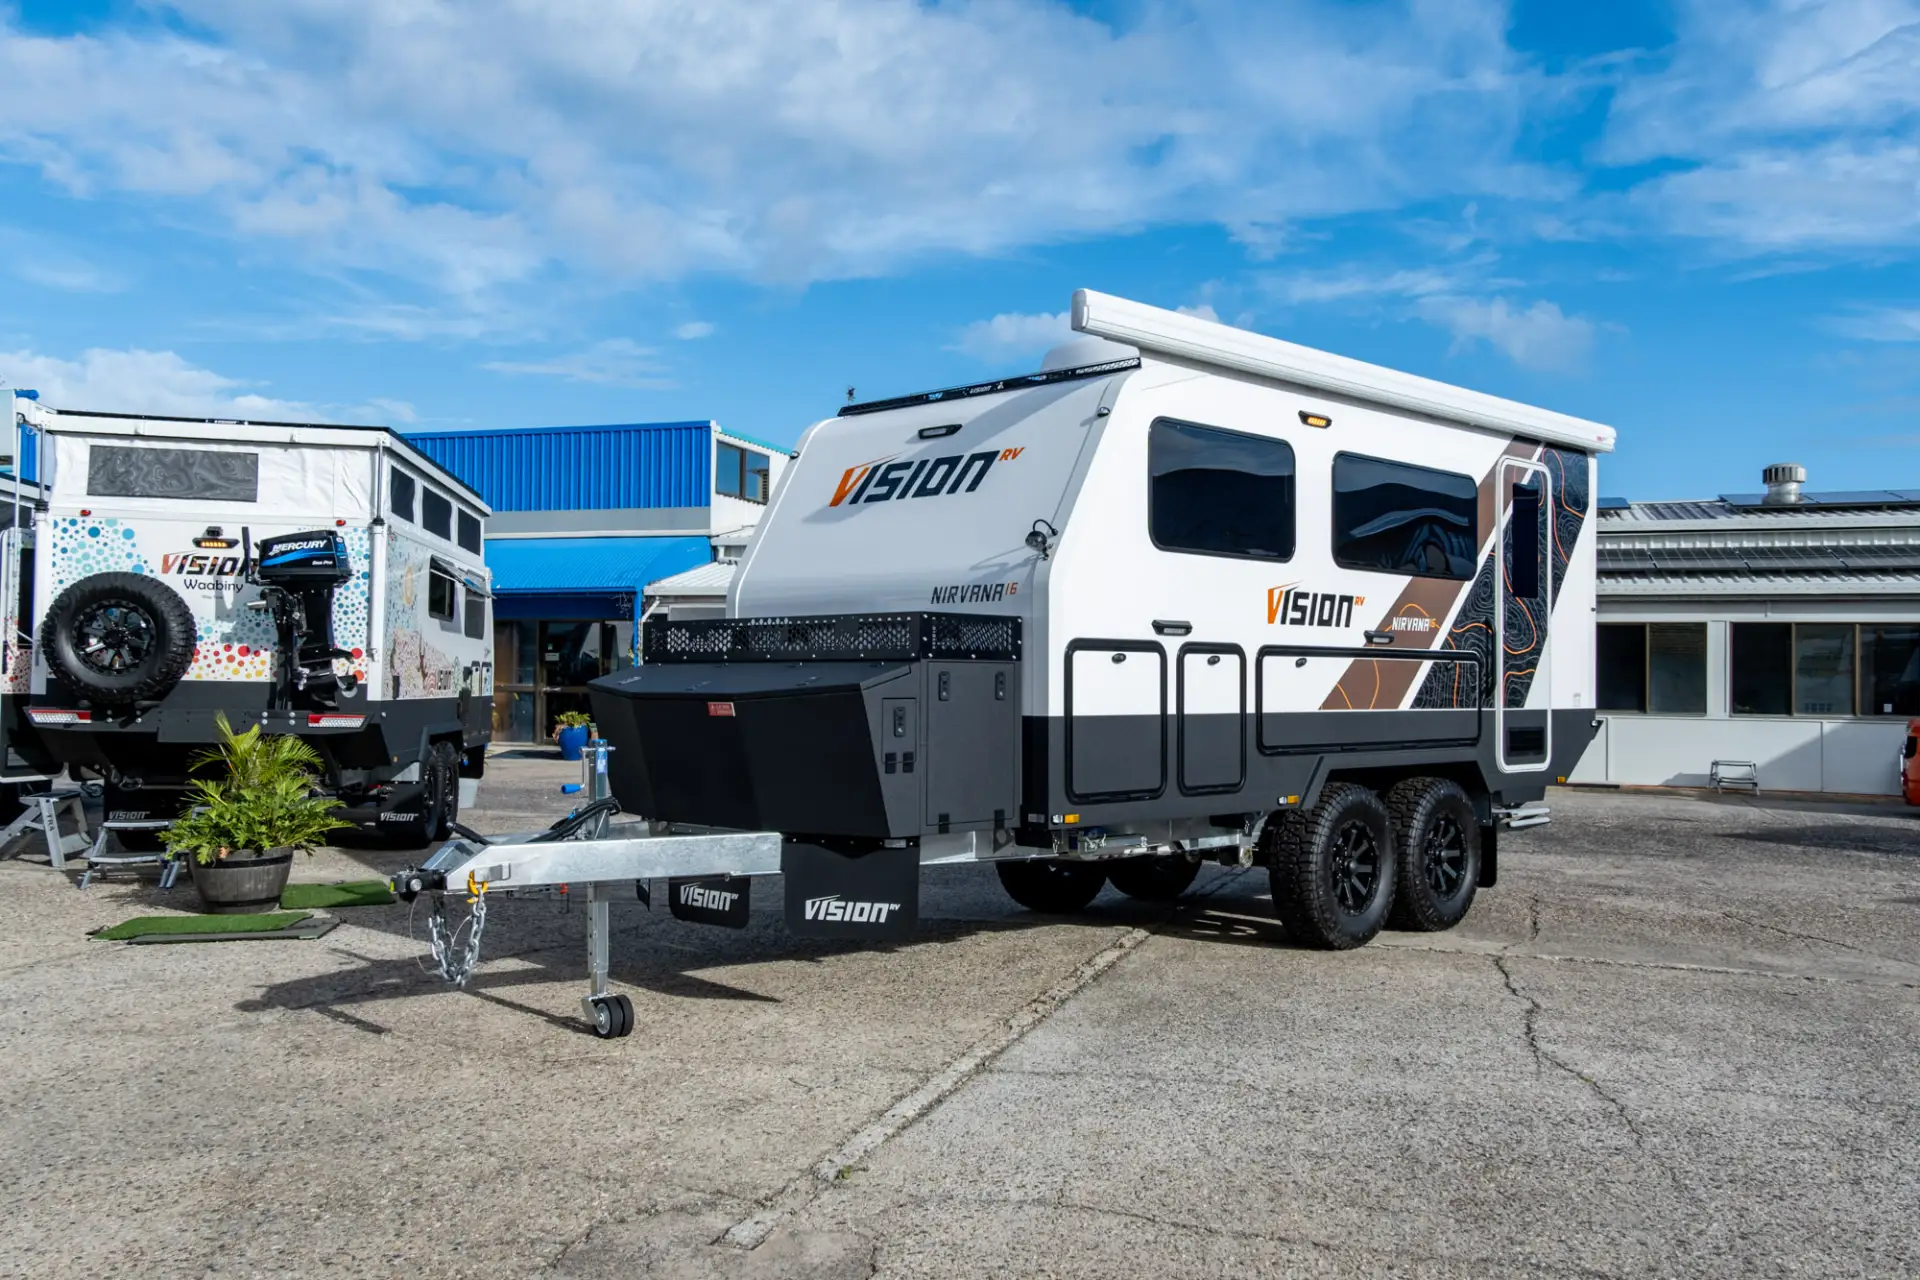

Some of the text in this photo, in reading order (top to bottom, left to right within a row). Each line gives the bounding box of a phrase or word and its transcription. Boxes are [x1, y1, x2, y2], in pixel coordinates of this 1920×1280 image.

[829, 447, 1026, 507] VISION RV
[269, 540, 327, 556] MERCURY
[183, 579, 244, 594] Waabiny
[931, 583, 1005, 604] NIRVANA
[1267, 583, 1366, 628] VISION RV
[1392, 616, 1430, 632] NIRVANA
[108, 811, 146, 820] VISION
[380, 811, 415, 821] VISION
[680, 884, 732, 911] VISION
[805, 896, 890, 923] VISION
